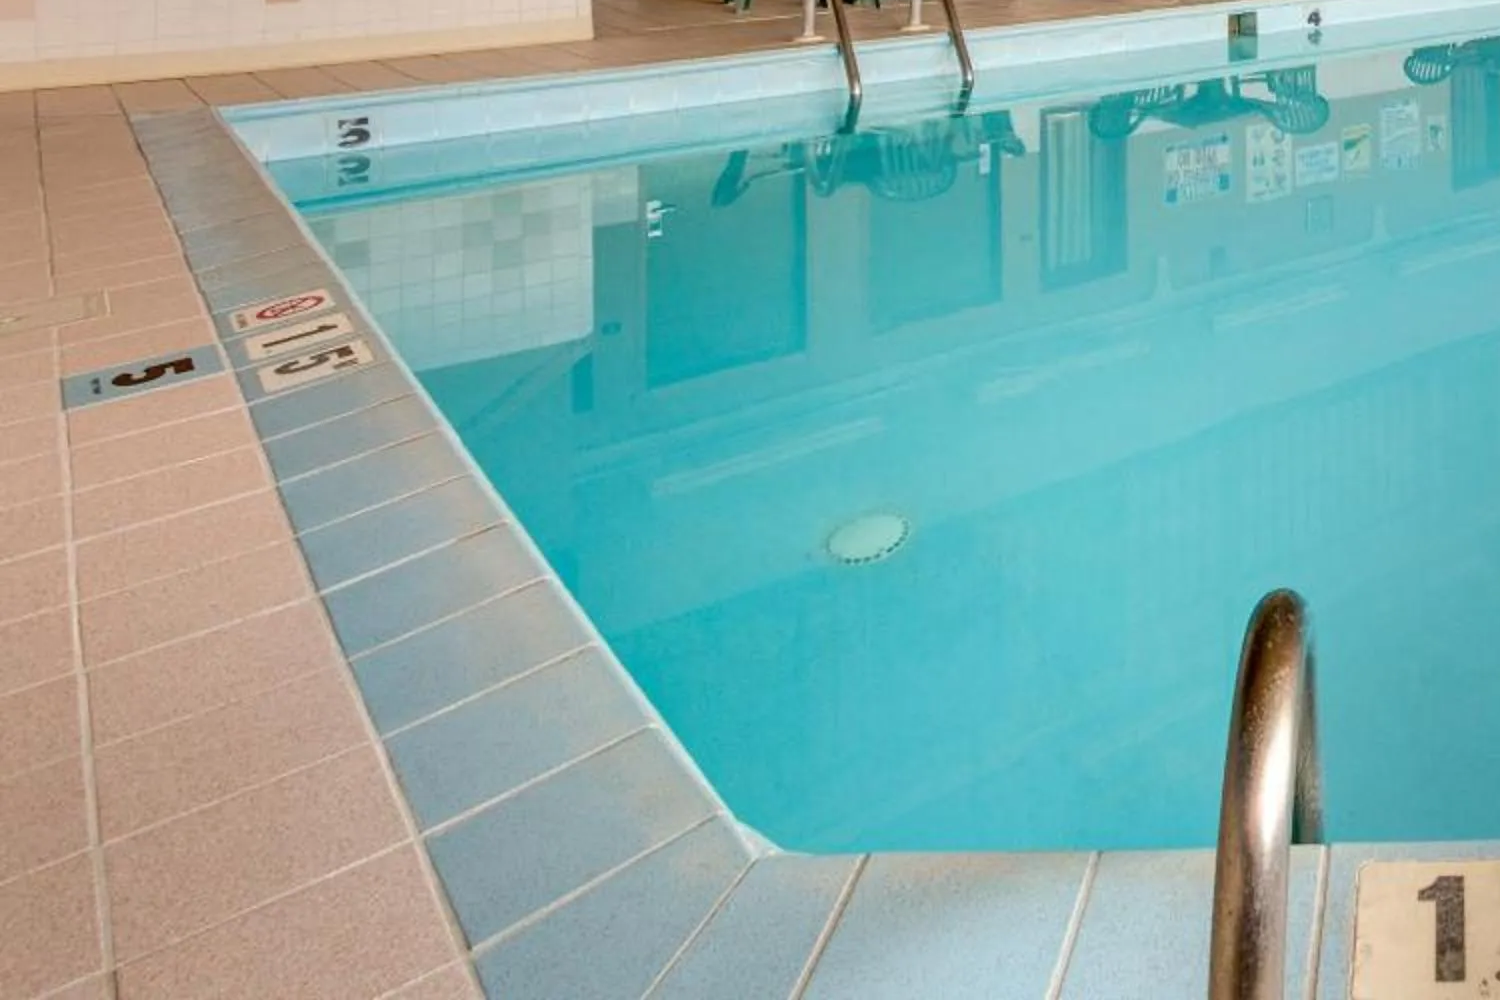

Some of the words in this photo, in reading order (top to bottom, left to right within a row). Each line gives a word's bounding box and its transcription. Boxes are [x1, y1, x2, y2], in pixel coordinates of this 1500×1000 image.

[1307, 8, 1321, 26] 4
[111, 357, 195, 386] 5
[273, 345, 353, 374] 5
